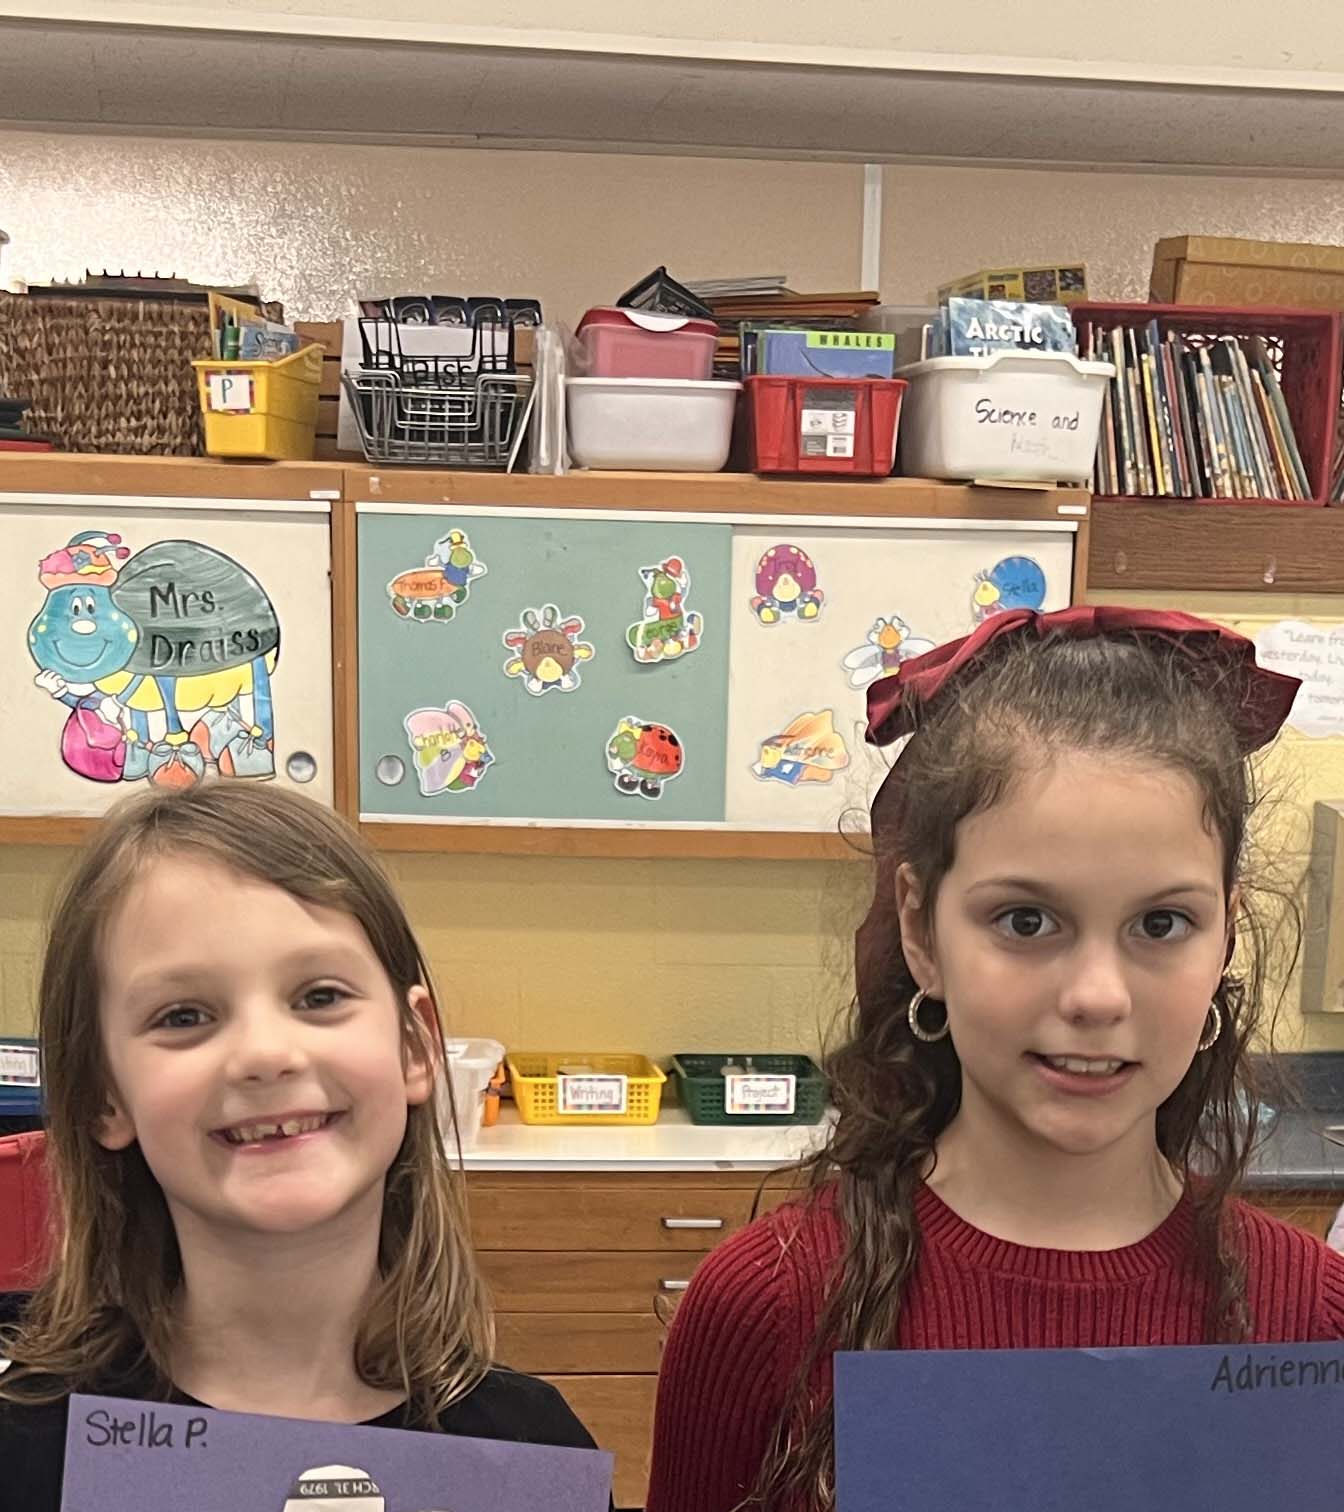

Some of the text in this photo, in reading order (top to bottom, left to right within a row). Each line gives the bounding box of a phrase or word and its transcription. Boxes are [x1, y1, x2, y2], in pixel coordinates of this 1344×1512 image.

[819, 333, 884, 348] WHALES
[966, 316, 1043, 344] ARCTIC
[221, 378, 233, 403] P
[975, 398, 1080, 431] Science and
[149, 581, 225, 620] Mrs.
[150, 627, 261, 669] Draiss
[569, 1080, 614, 1102] Writing
[741, 1085, 782, 1102] Project
[84, 1410, 209, 1449] Stella P.
[300, 1482, 329, 1495] 1979
